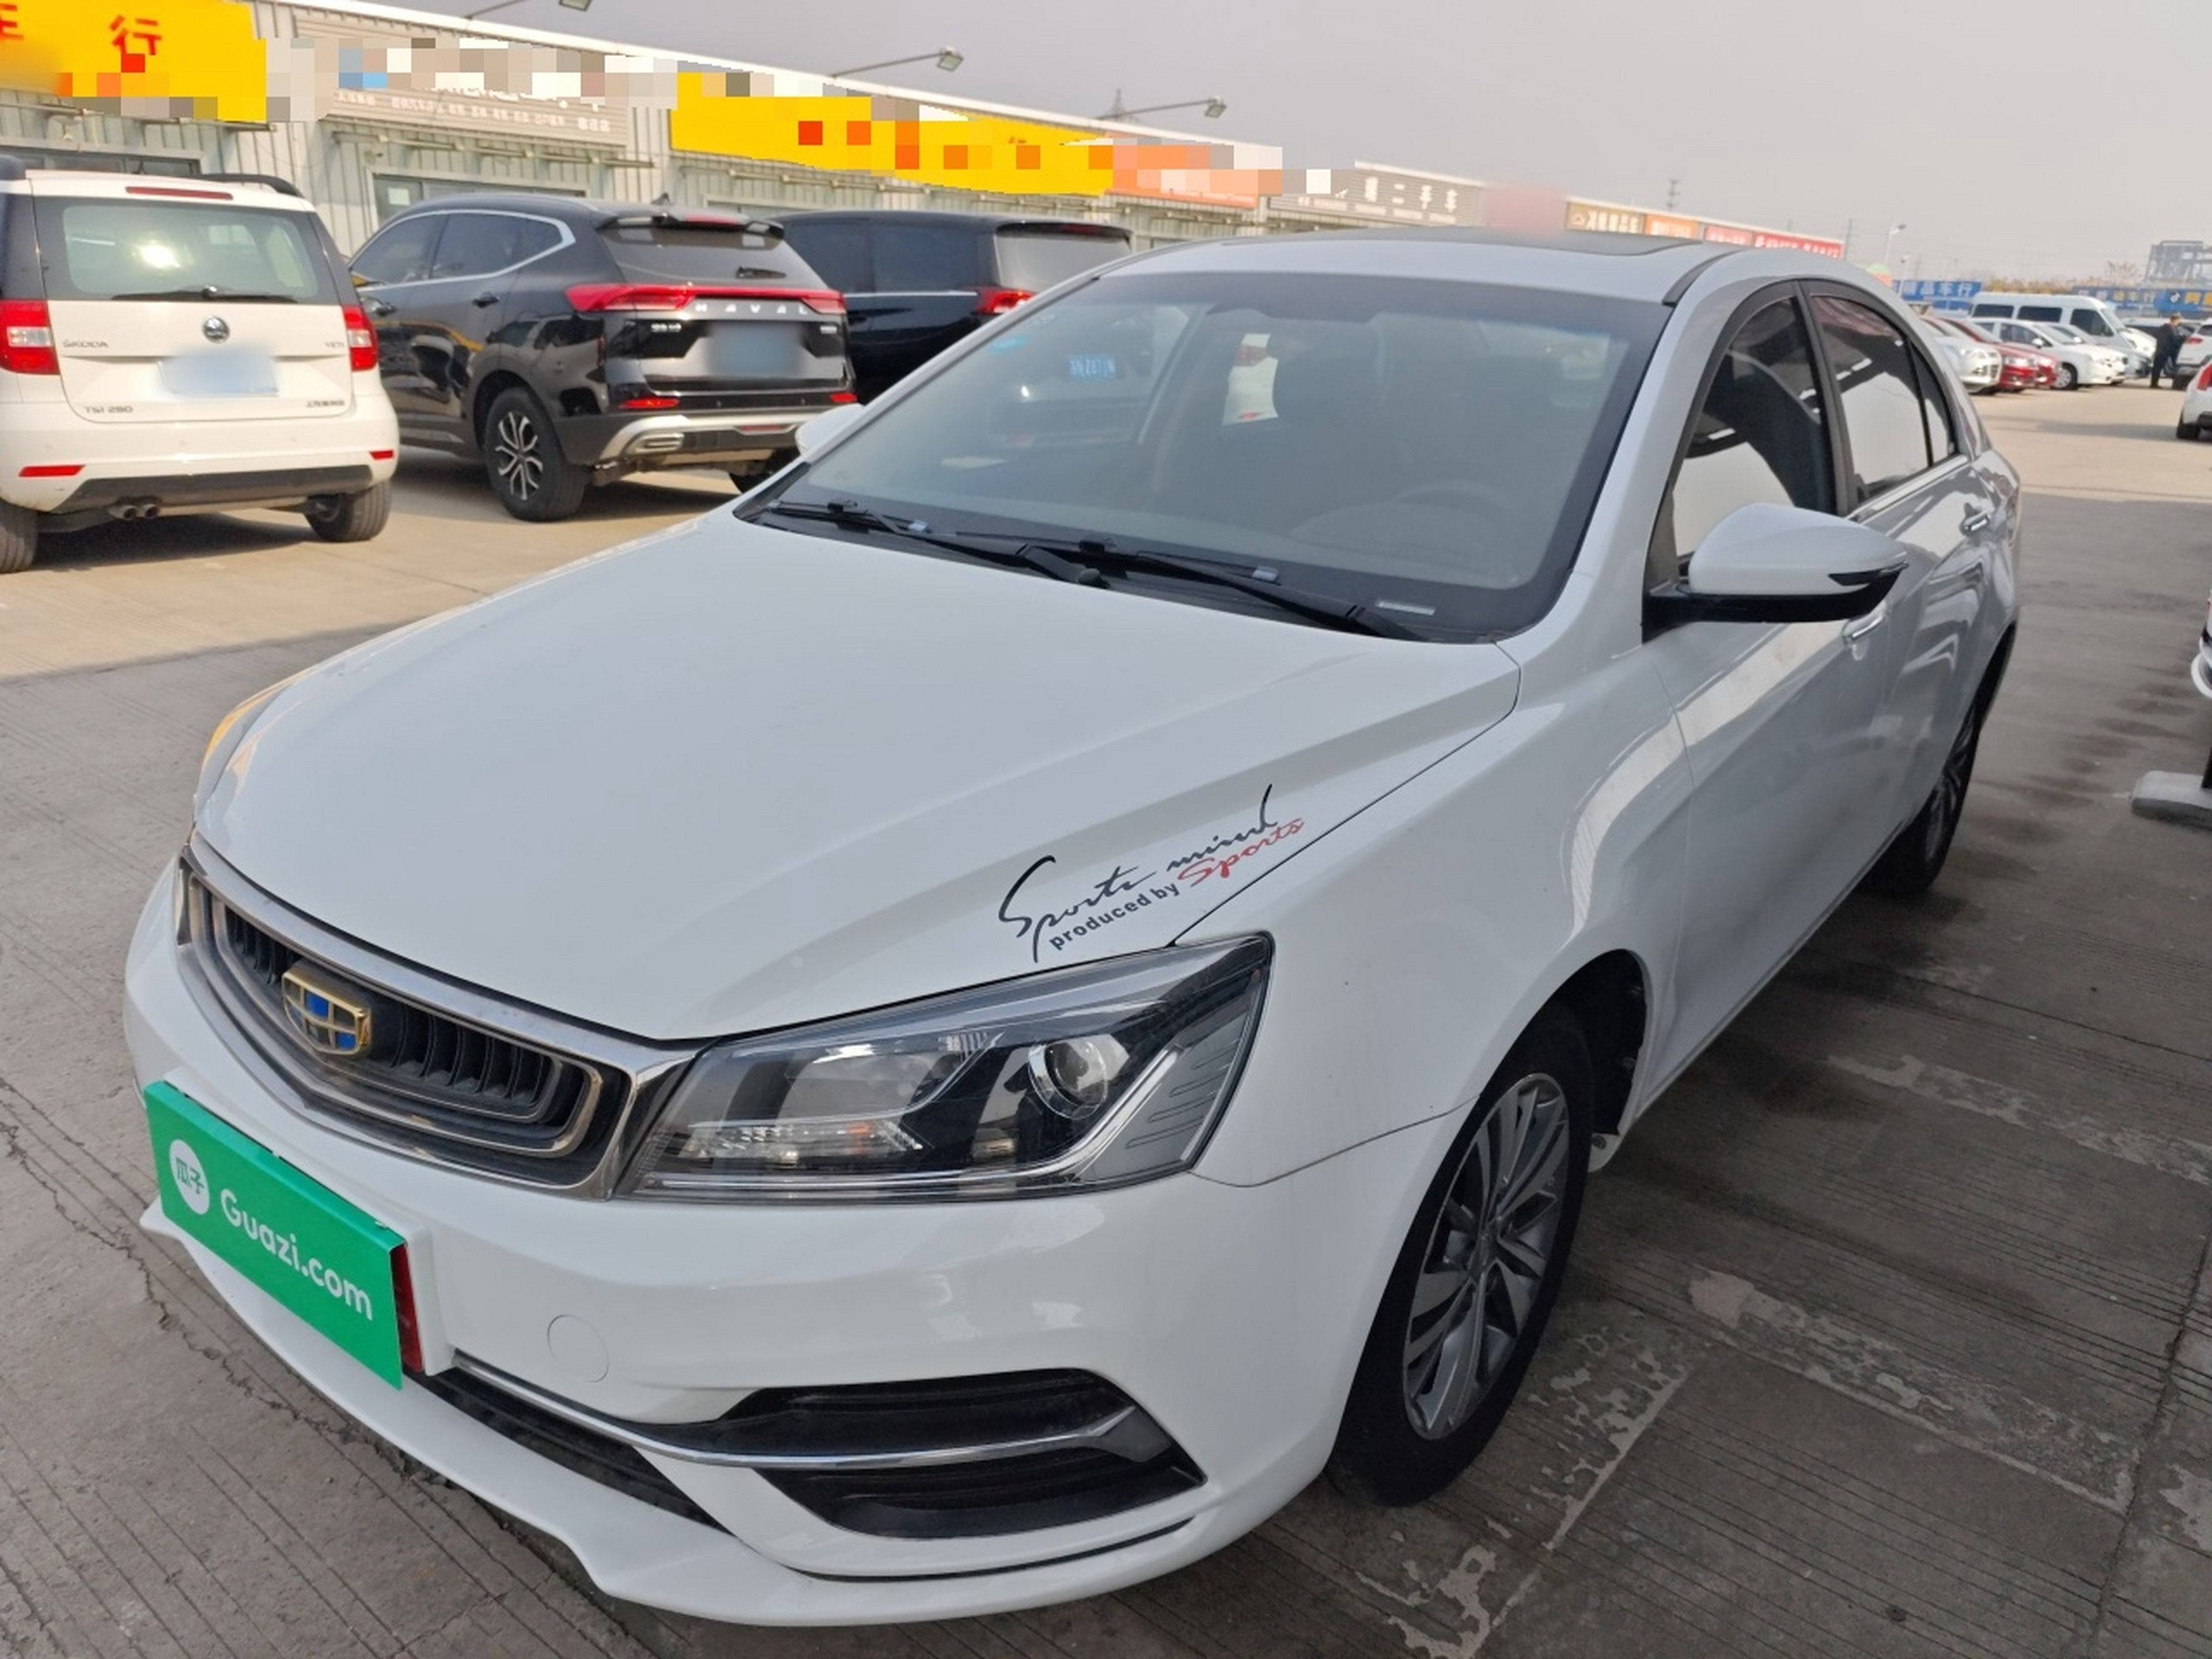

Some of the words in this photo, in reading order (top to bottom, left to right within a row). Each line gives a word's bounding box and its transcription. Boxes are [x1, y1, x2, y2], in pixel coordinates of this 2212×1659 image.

[695, 303, 807, 315] HAVAL
[108, 406, 133, 414] 280
[1049, 893, 1152, 950] produced
[1150, 884, 1180, 906] by
[1177, 818, 1304, 887] Sports
[175, 1156, 206, 1196] 瓜子
[220, 1188, 373, 1321] Guazi.com
